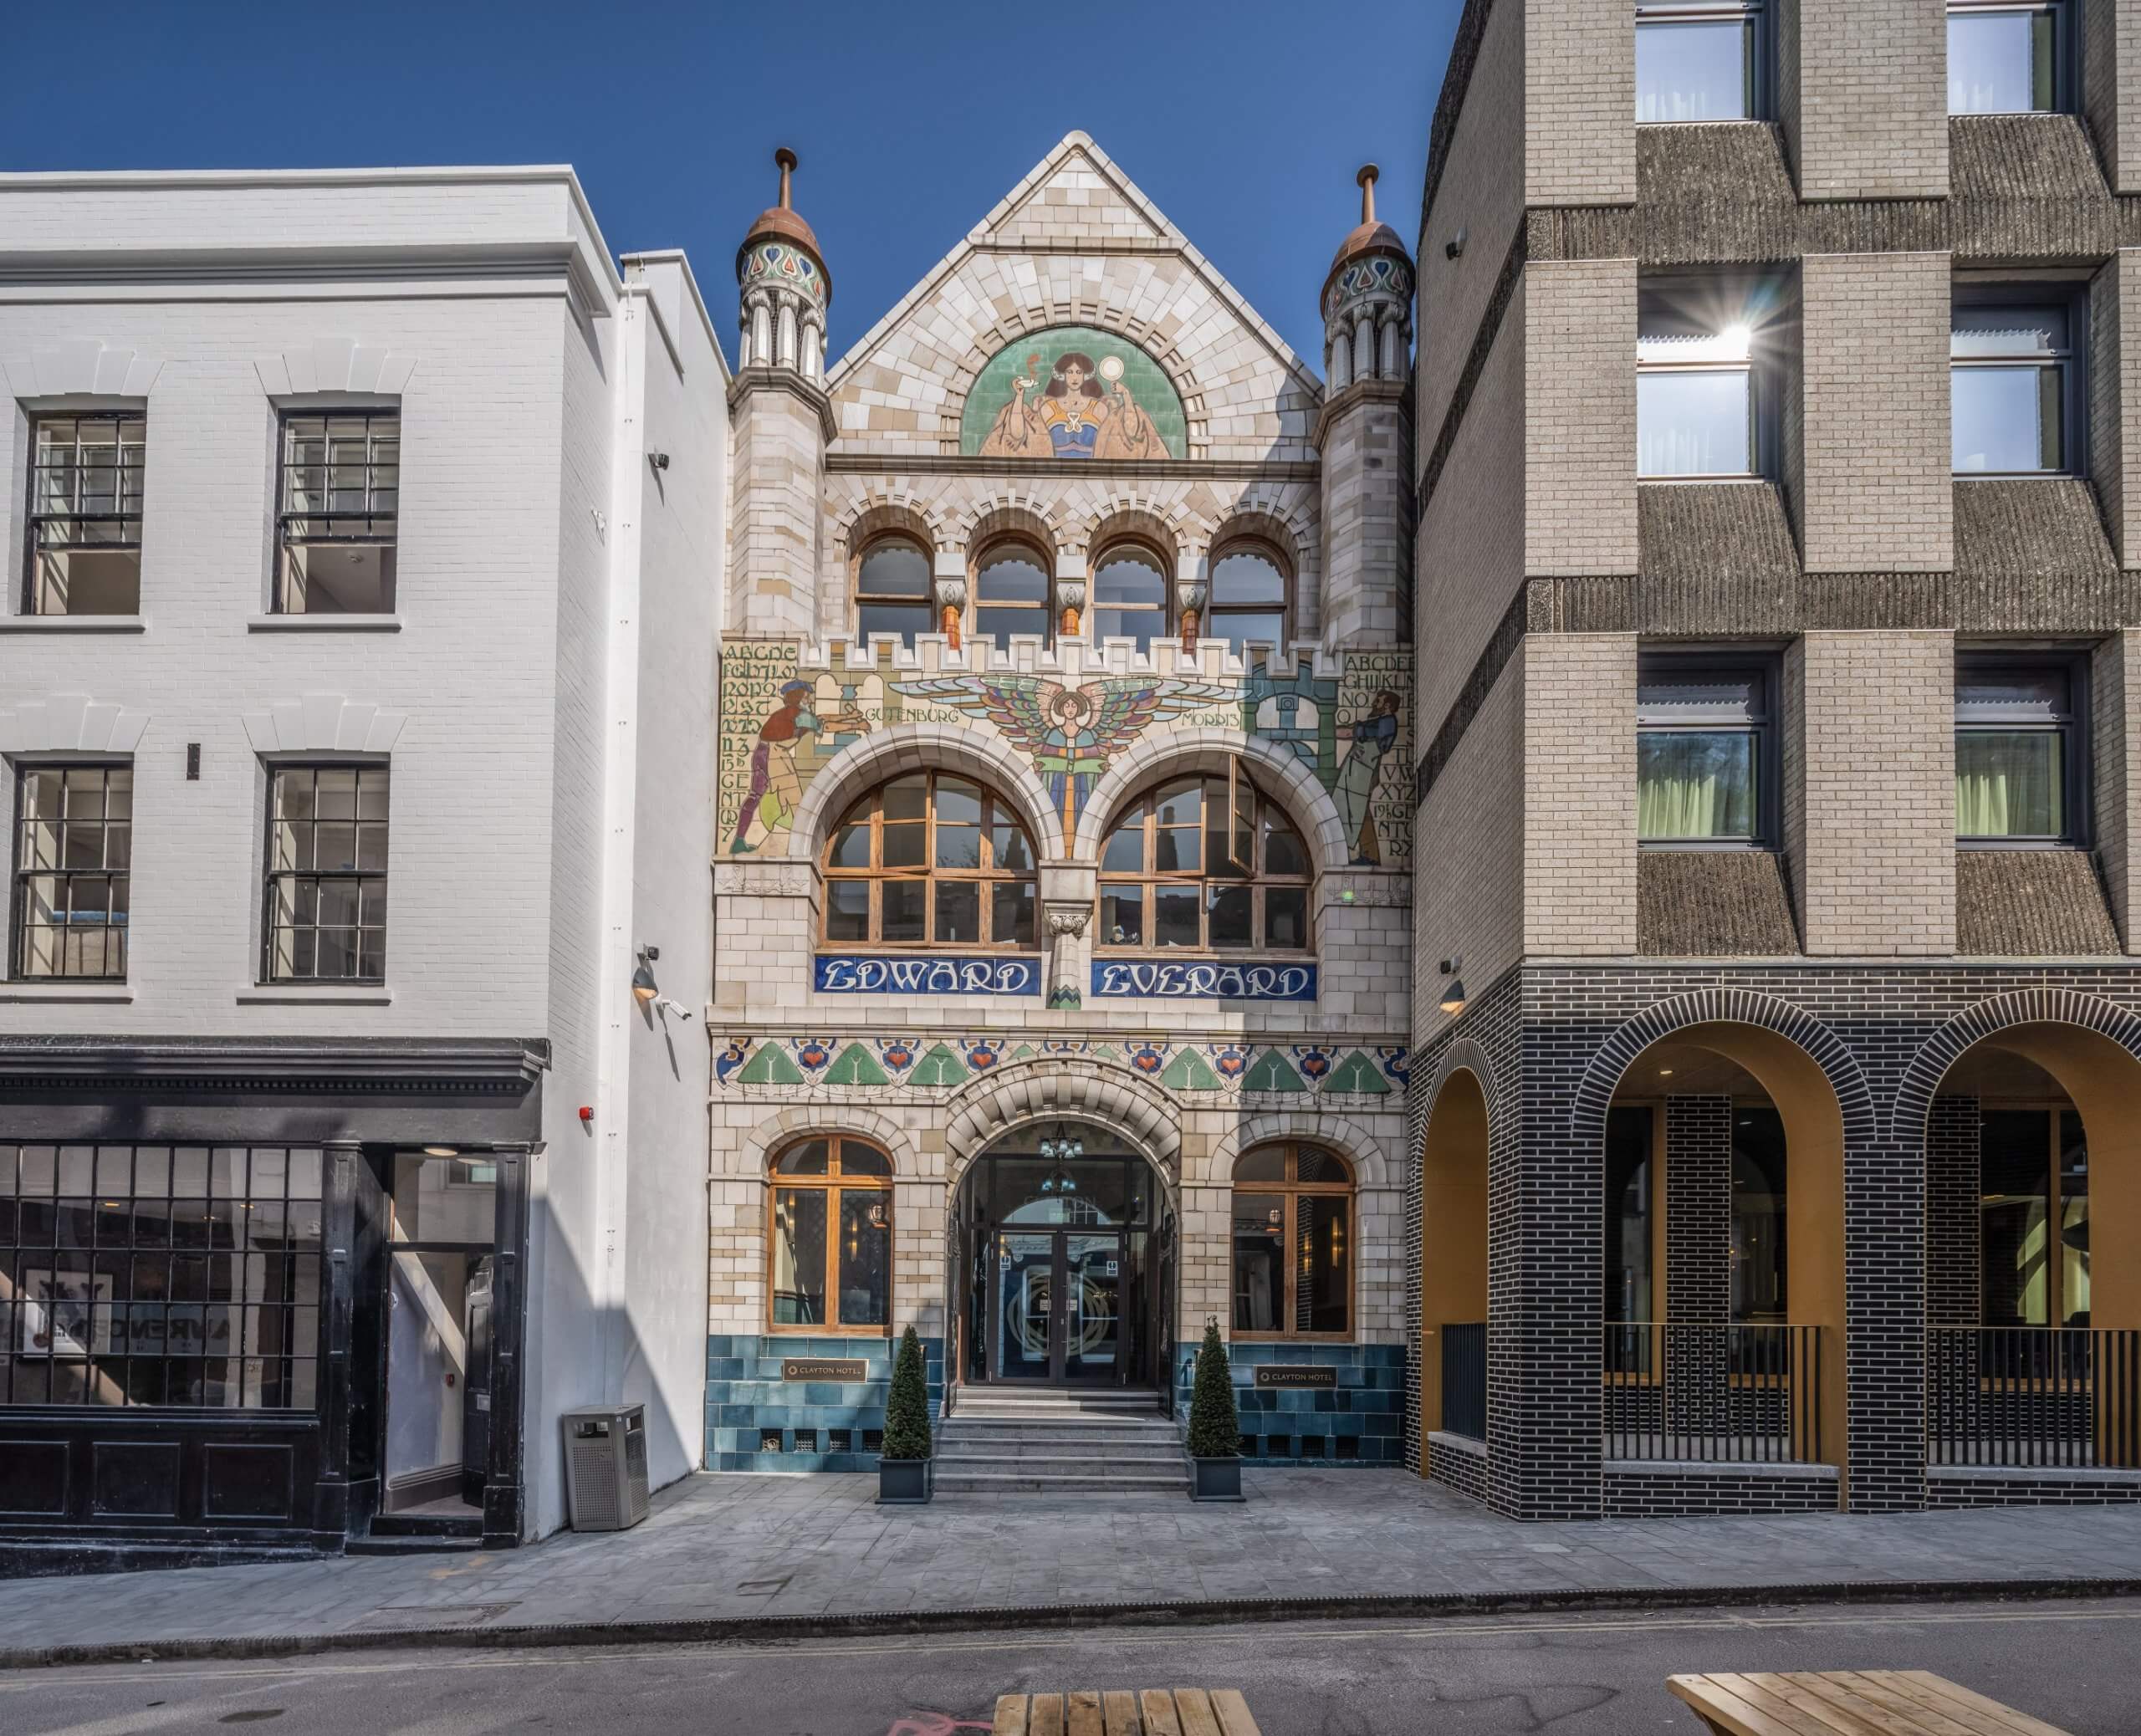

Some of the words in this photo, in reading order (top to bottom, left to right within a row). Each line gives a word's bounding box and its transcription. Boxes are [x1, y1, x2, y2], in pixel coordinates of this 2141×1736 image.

[723, 646, 796, 661] ABCDE
[865, 707, 958, 722] GUTENBURG
[1182, 712, 1239, 727] MORRIS
[823, 959, 1030, 993] EDWARD
[1100, 963, 1309, 996] EVERARD
[800, 1366, 835, 1375] CLAYTON
[1271, 1373, 1306, 1381] CLAYTON
